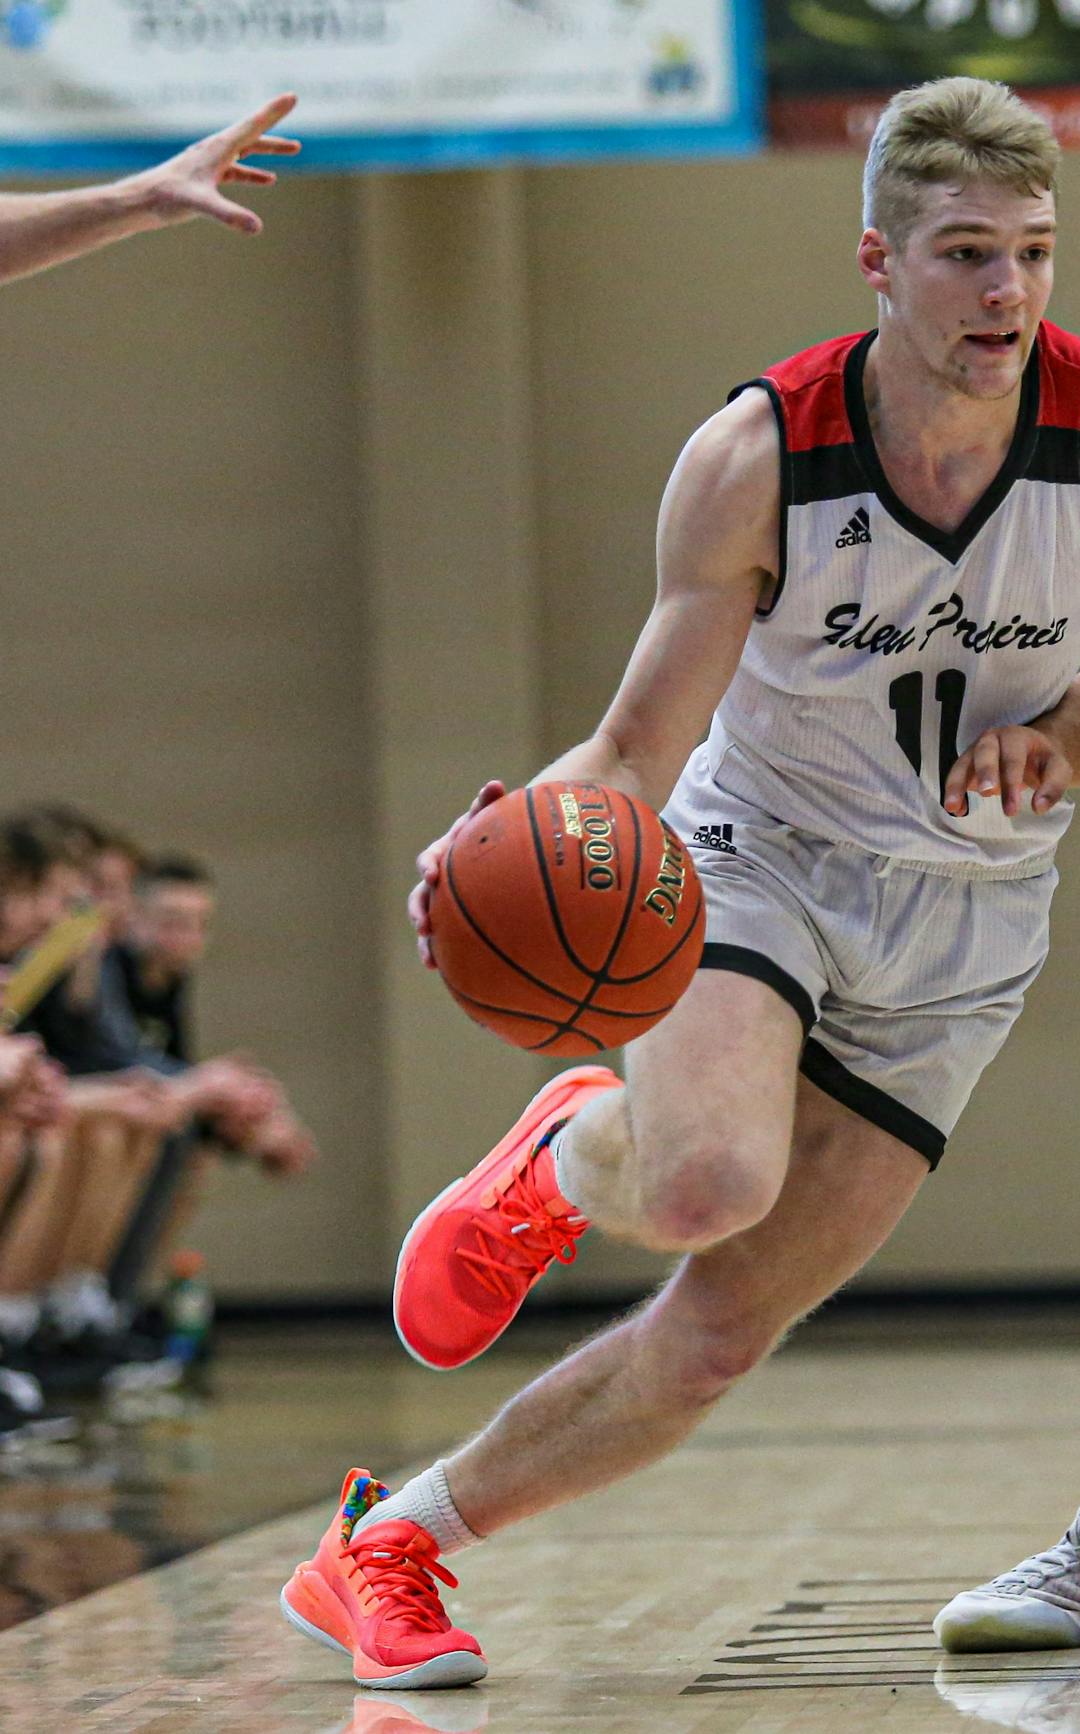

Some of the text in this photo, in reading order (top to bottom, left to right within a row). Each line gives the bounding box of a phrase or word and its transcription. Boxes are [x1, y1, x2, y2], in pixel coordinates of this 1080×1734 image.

[835, 530, 872, 548] adid
[822, 602, 915, 655] Eden
[889, 667, 969, 816] 11
[693, 831, 737, 855] adidas
